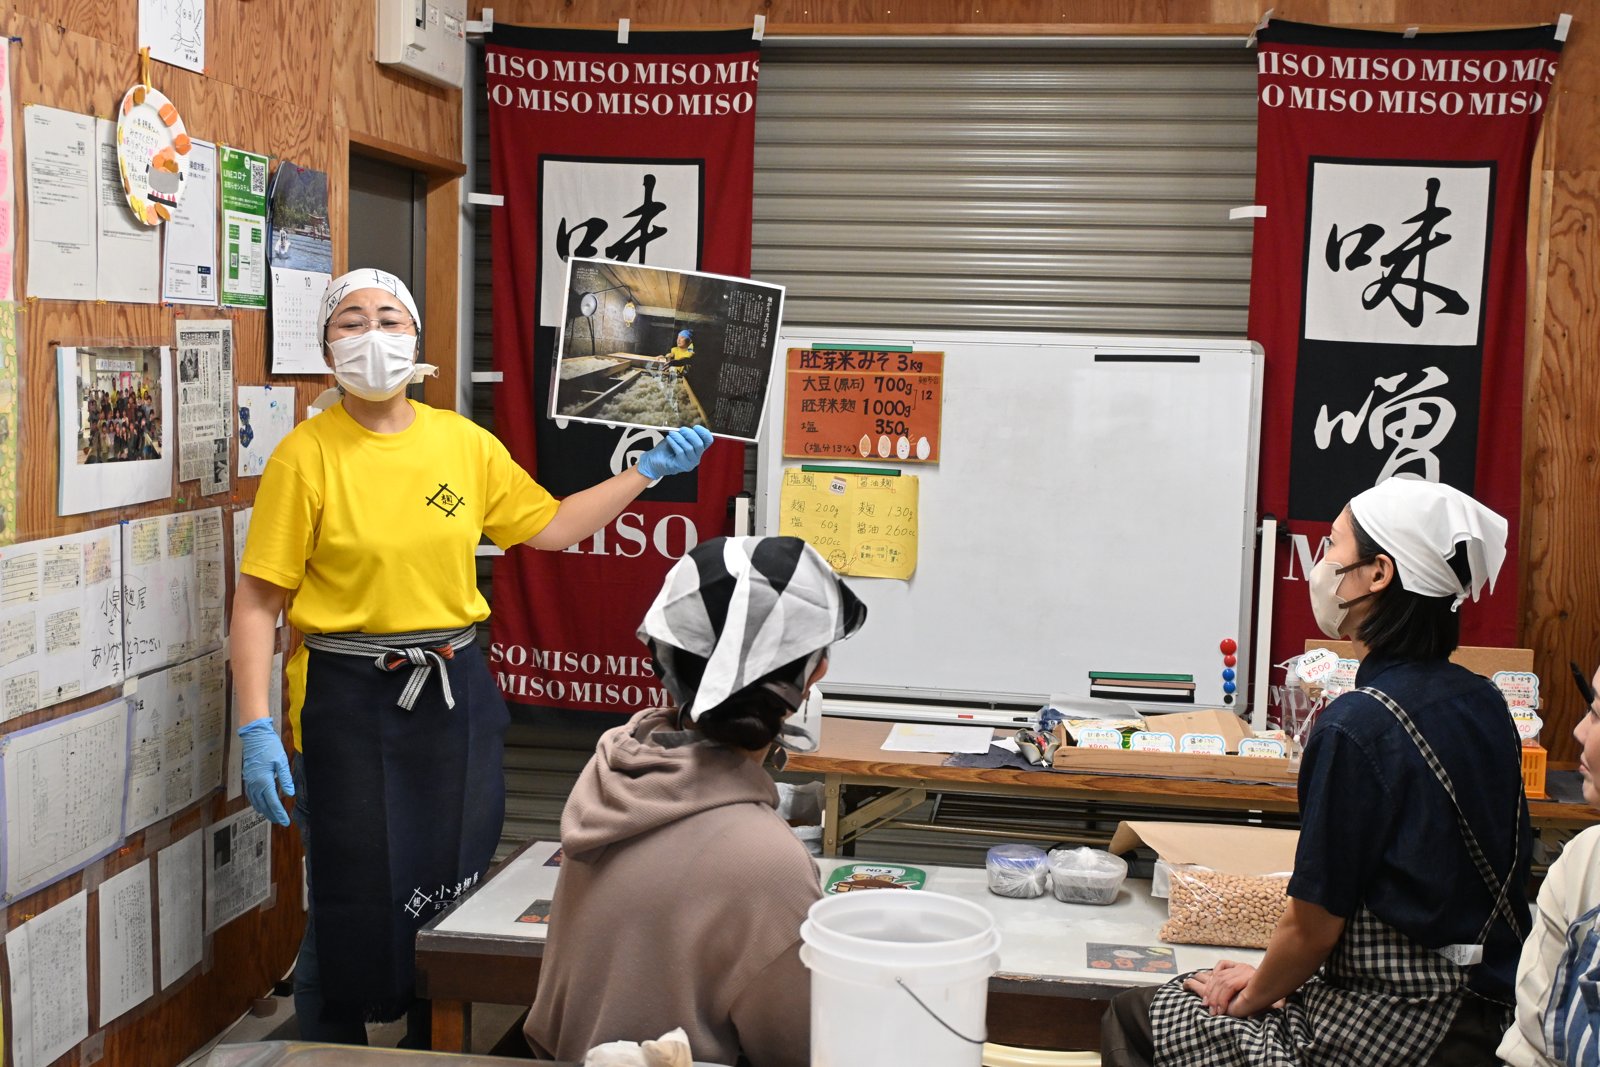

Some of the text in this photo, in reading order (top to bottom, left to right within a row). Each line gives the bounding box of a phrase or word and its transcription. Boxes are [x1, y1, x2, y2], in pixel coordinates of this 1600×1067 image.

[553, 59, 630, 84] MISO
[633, 62, 712, 85] MISO
[1329, 55, 1416, 81] MISO
[1420, 58, 1508, 83] MISO
[516, 87, 593, 114] MISO
[596, 91, 674, 116] MISO
[677, 91, 753, 116] MISO
[1288, 85, 1374, 113] MISO
[1377, 89, 1464, 116] MISO
[1467, 91, 1542, 116] MISO
[897, 354, 923, 373] 3kg
[874, 376, 913, 396] 700g
[921, 390, 932, 400] 12
[862, 398, 911, 418] 1000g
[800, 418, 909, 438] 塩 350g
[490, 642, 656, 678] SO MISO MIS
[1306, 661, 1331, 679] ¥500
[496, 671, 565, 700] MISO
[569, 681, 643, 707] MISO
